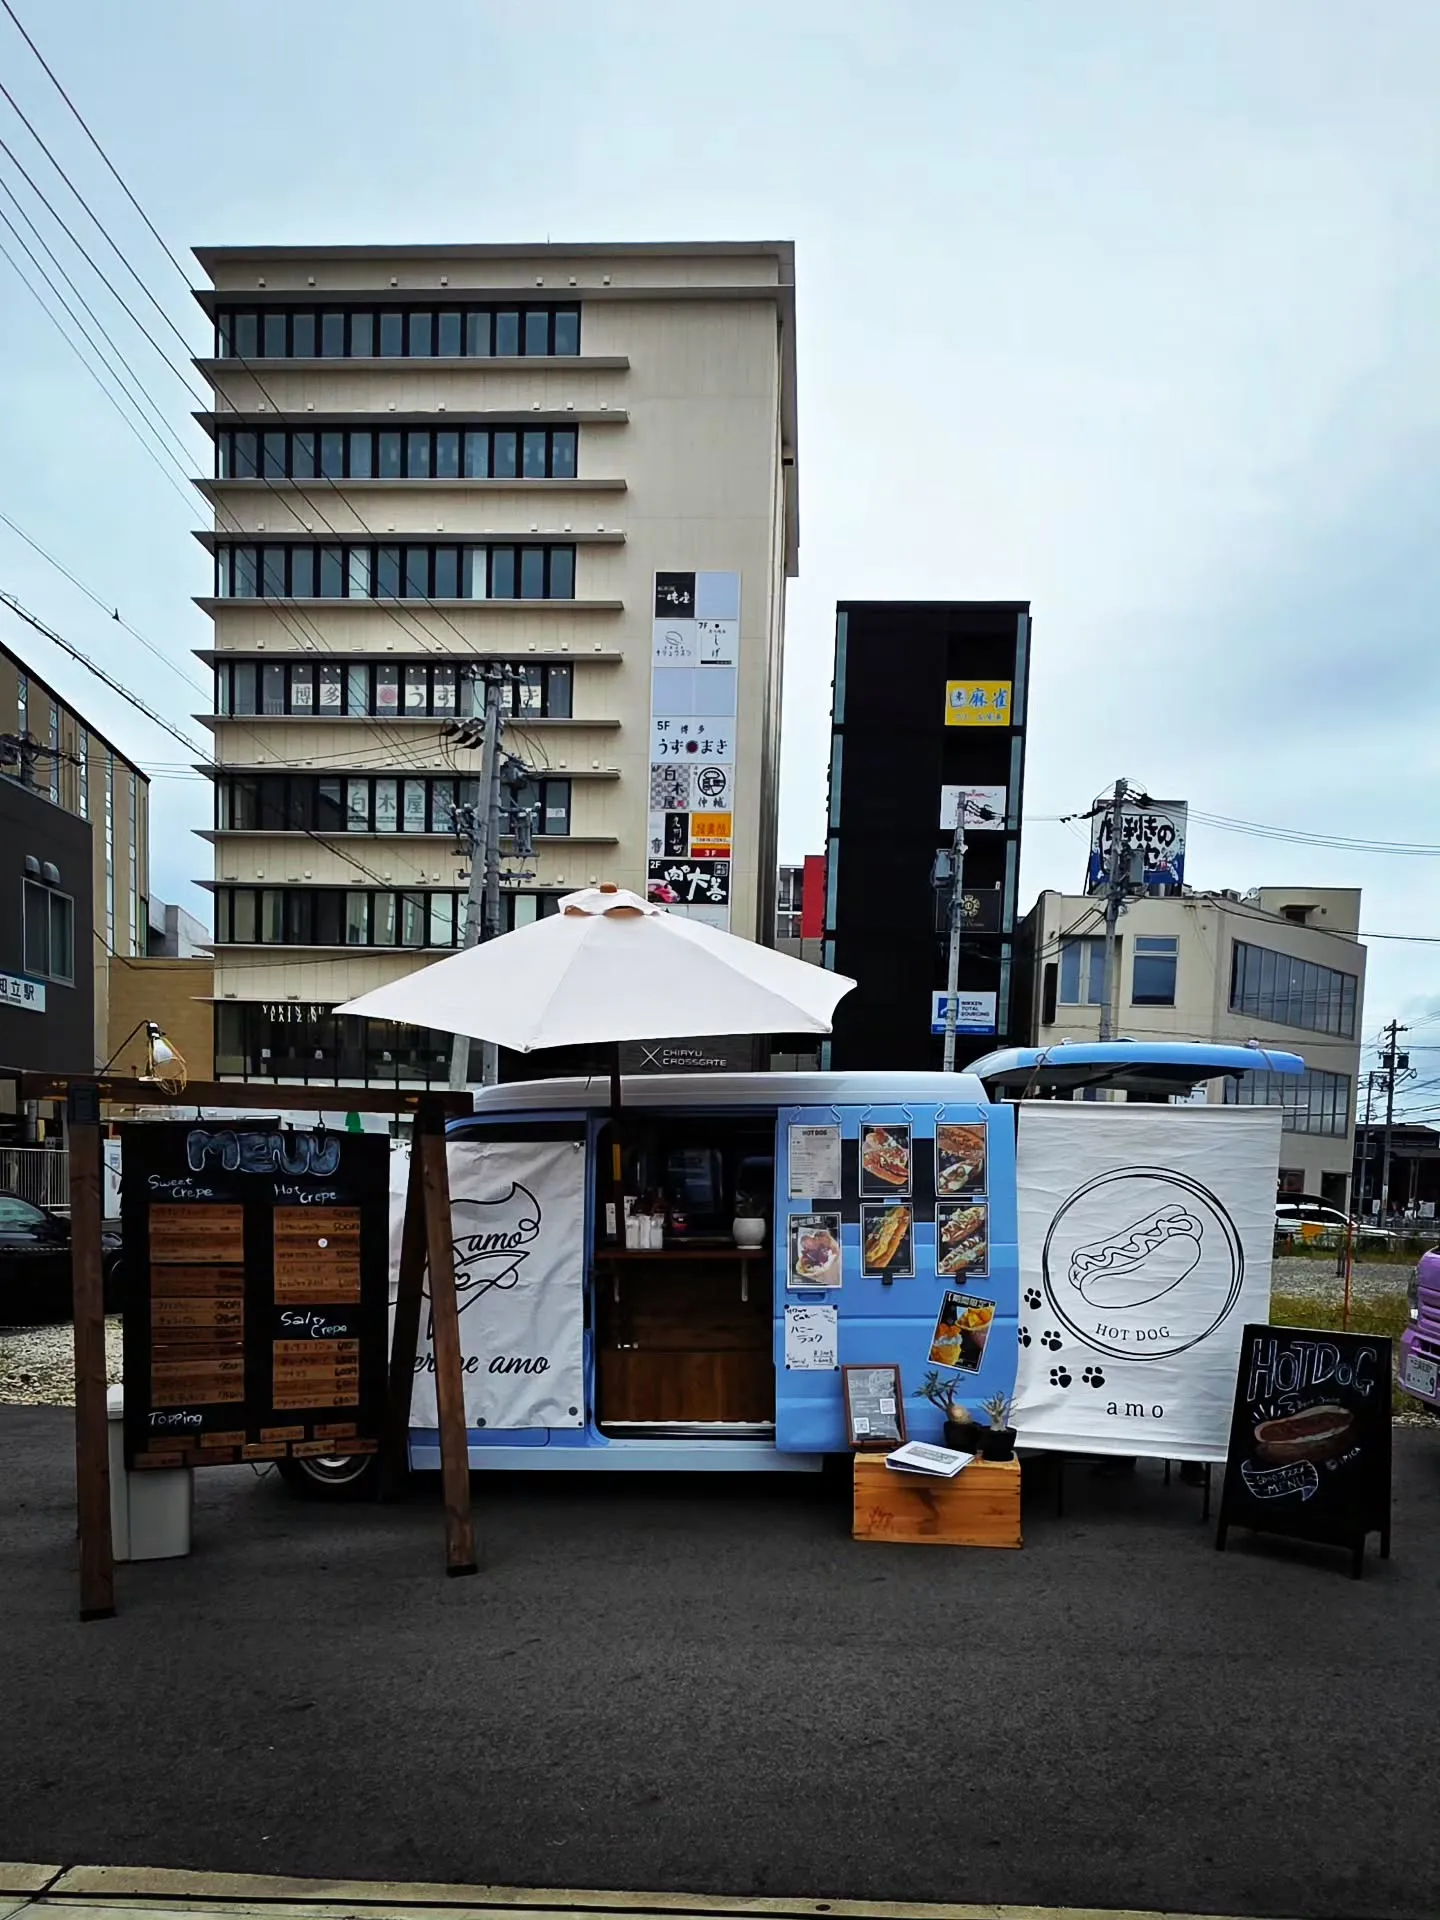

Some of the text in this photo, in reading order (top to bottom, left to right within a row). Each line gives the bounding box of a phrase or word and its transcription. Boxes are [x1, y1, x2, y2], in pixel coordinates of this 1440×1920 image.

[295, 686, 341, 704] 博多
[969, 688, 1008, 709] 麻雀
[657, 721, 670, 731] 5F
[680, 724, 705, 735] 博多
[662, 765, 685, 809] 白木屋
[349, 792, 425, 814] 白木屋
[662, 1058, 727, 1067] CROSSGATE
[187, 1130, 341, 1176] MENU
[468, 1230, 522, 1252] amo
[1095, 1323, 1171, 1341] HOT DOG
[488, 1355, 550, 1375] amo
[148, 1411, 203, 1426] Topping
[1106, 1401, 1164, 1419] amo
